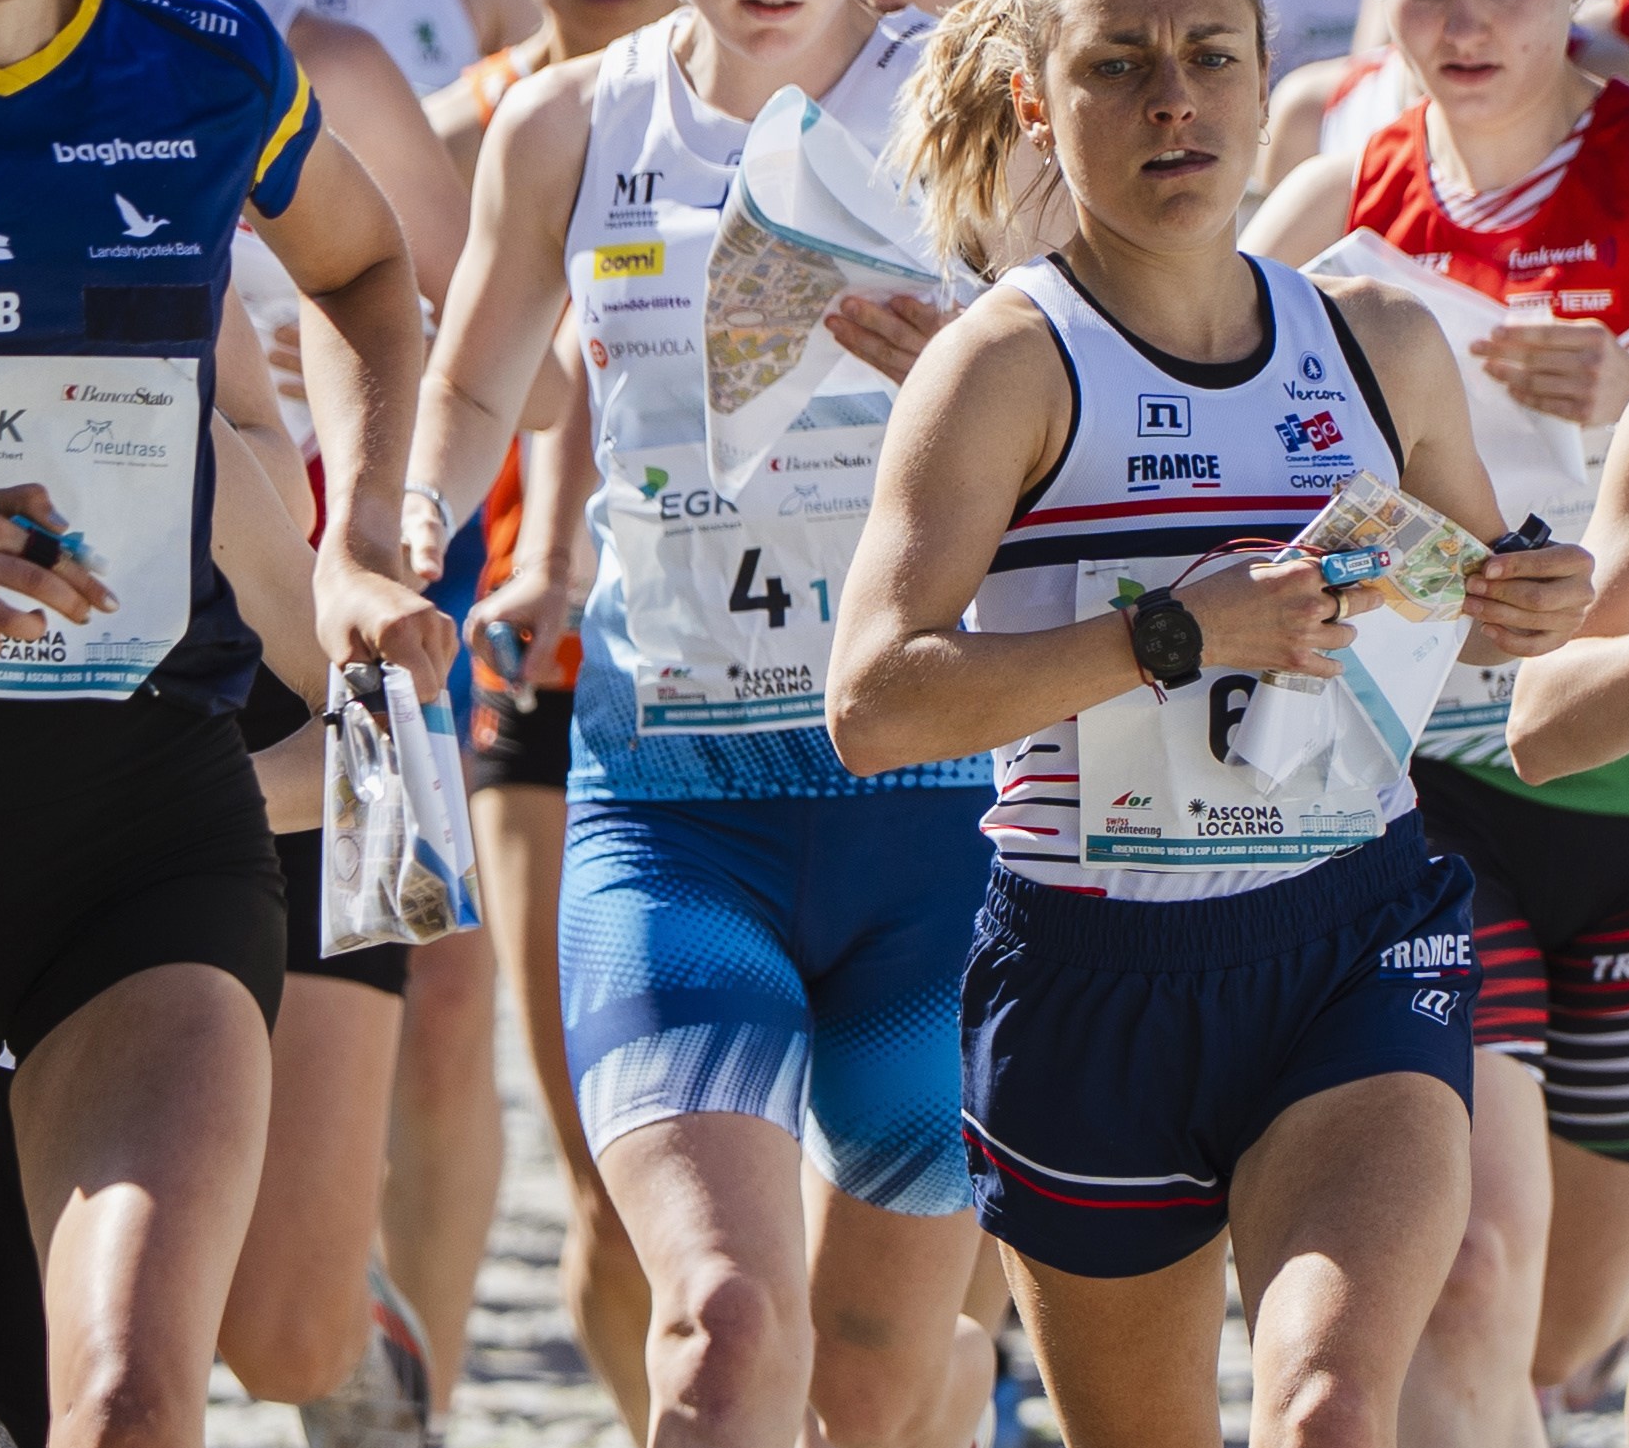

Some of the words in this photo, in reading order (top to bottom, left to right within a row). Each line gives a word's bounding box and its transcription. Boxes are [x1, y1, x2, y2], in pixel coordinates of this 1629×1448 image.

[53, 138, 197, 166] bagheera
[613, 171, 665, 206] MT
[1508, 239, 1597, 269] funkwerk
[80, 385, 174, 407] BancaStato
[1283, 381, 1346, 401] Vercors
[94, 440, 167, 458] neutrass
[1127, 454, 1221, 482] FRANCE
[729, 547, 792, 629] 4
[810, 578, 830, 623] 1
[743, 664, 812, 684] ASCONA
[734, 679, 814, 700] LOCARNO
[1209, 674, 1260, 765] 6
[1207, 806, 1283, 821] ASCONA
[1197, 821, 1284, 837] LOCARNO
[1167, 846, 1195, 856] WORLD
[1196, 846, 1211, 856] CUP
[1212, 845, 1247, 856] LOCARNO
[1248, 845, 1279, 855] ASCONA
